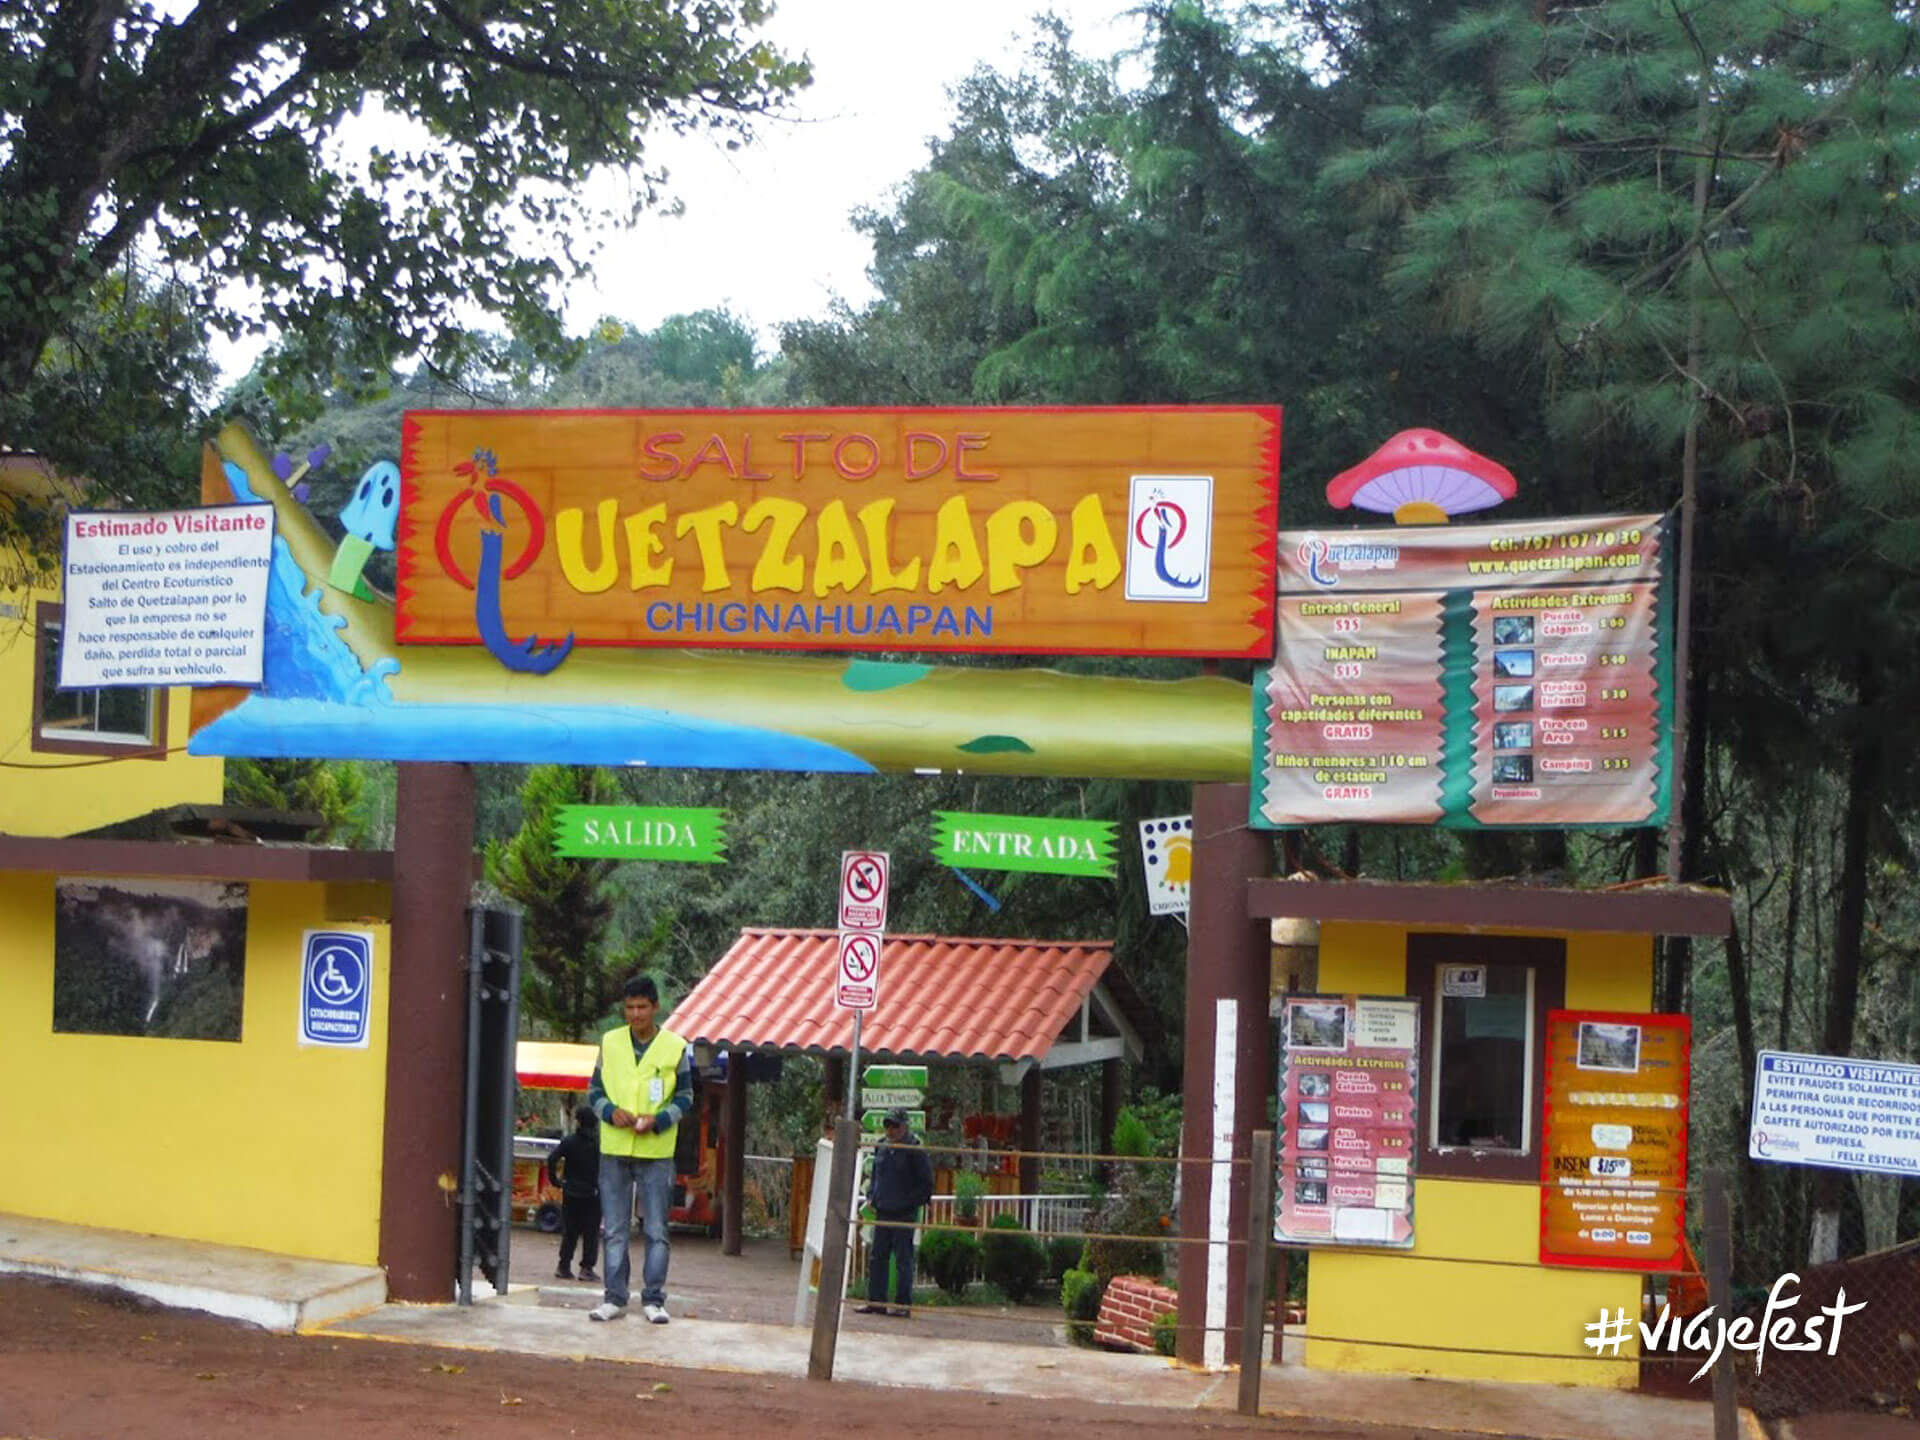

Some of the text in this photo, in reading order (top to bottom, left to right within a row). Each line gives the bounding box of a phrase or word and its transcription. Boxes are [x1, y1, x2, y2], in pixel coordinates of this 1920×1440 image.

[639, 431, 1001, 481] SALTO DE
[75, 513, 266, 538] Estimado Visitante
[1595, 531, 1615, 546] 70
[1620, 530, 1642, 545] 30
[118, 540, 219, 557] El uso y cobro del
[69, 556, 270, 575] Estacionamiento es independiente
[1468, 553, 1640, 574] www.quetzalapan.com
[102, 579, 118, 591] del
[122, 578, 160, 590] Centro
[88, 593, 247, 608] Salto de Quetzalapan por lo
[1301, 601, 1400, 615] Entrada General
[1492, 591, 1633, 609] Actividades Extremas
[105, 613, 227, 626] que la empresa no se
[646, 601, 993, 636] CHIGNAHUAPAN
[1543, 612, 1581, 621] Puente
[78, 627, 254, 643] hace responsable de cualquier
[164, 646, 191, 657] total
[194, 648, 202, 657] o
[205, 645, 246, 658] parcial
[102, 667, 123, 679] que
[126, 665, 154, 676] sufra
[158, 667, 171, 675] su
[1311, 694, 1392, 706] Personas con
[1280, 709, 1423, 722] capacidades diferentes
[1325, 726, 1372, 738] GRATIS
[1276, 753, 1309, 767] Niños
[1313, 757, 1365, 767] menores
[1409, 757, 1427, 767] cm
[1542, 760, 1590, 771] Camping
[1314, 771, 1386, 782] de estatura
[1325, 788, 1371, 799] GRATIS
[584, 819, 697, 847] SALIDA
[952, 830, 1098, 861] ENTRADA
[1295, 1055, 1405, 1070] Actividades Extremas
[1773, 1059, 1845, 1076] ESTIMADO
[1768, 1074, 1799, 1086] EVITE
[1800, 1077, 1845, 1091] FRAUDES
[1847, 1082, 1910, 1097] SOLAMENTE
[1766, 1088, 1819, 1102] PERMITIRA
[1823, 1094, 1855, 1106] GUIAR
[1760, 1102, 1767, 1111] A
[1770, 1103, 1788, 1112] LAS
[1791, 1104, 1845, 1119] PERSONAS
[1847, 1110, 1868, 1122] QUE
[1872, 1112, 1911, 1126] PORTEN
[1763, 1116, 1800, 1128] GAFETE
[1804, 1120, 1869, 1135] AUTORIZADO
[1872, 1127, 1893, 1137] POR
[1837, 1151, 1865, 1162] FELIZ
[1868, 1153, 1918, 1168] ESTANCIA
